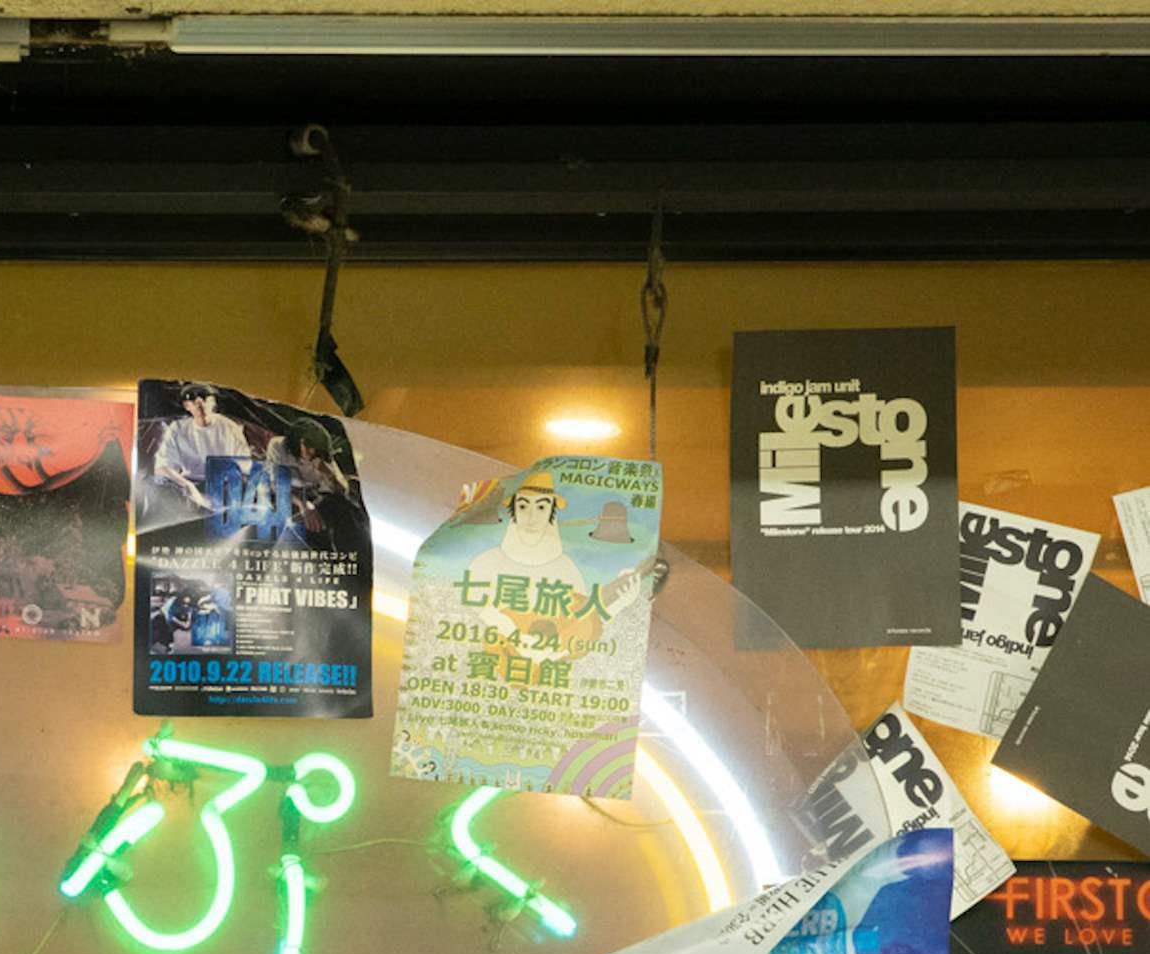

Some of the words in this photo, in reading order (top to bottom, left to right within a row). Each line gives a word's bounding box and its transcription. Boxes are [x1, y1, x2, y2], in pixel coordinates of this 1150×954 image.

[561, 472, 658, 492] MAGICWAYS
[453, 570, 612, 622] 七尾旅人
[436, 620, 563, 652] 2016.4.24
[568, 637, 618, 656] (sun)
[150, 660, 253, 684] 2010.9.22
[433, 653, 458, 674] at
[407, 677, 455, 695] OPEN
[460, 682, 509, 701] 18:30
[518, 689, 574, 708] START
[580, 694, 630, 712] 19:00
[1006, 928, 1047, 945] WE
[1064, 928, 1133, 945] LOVE
